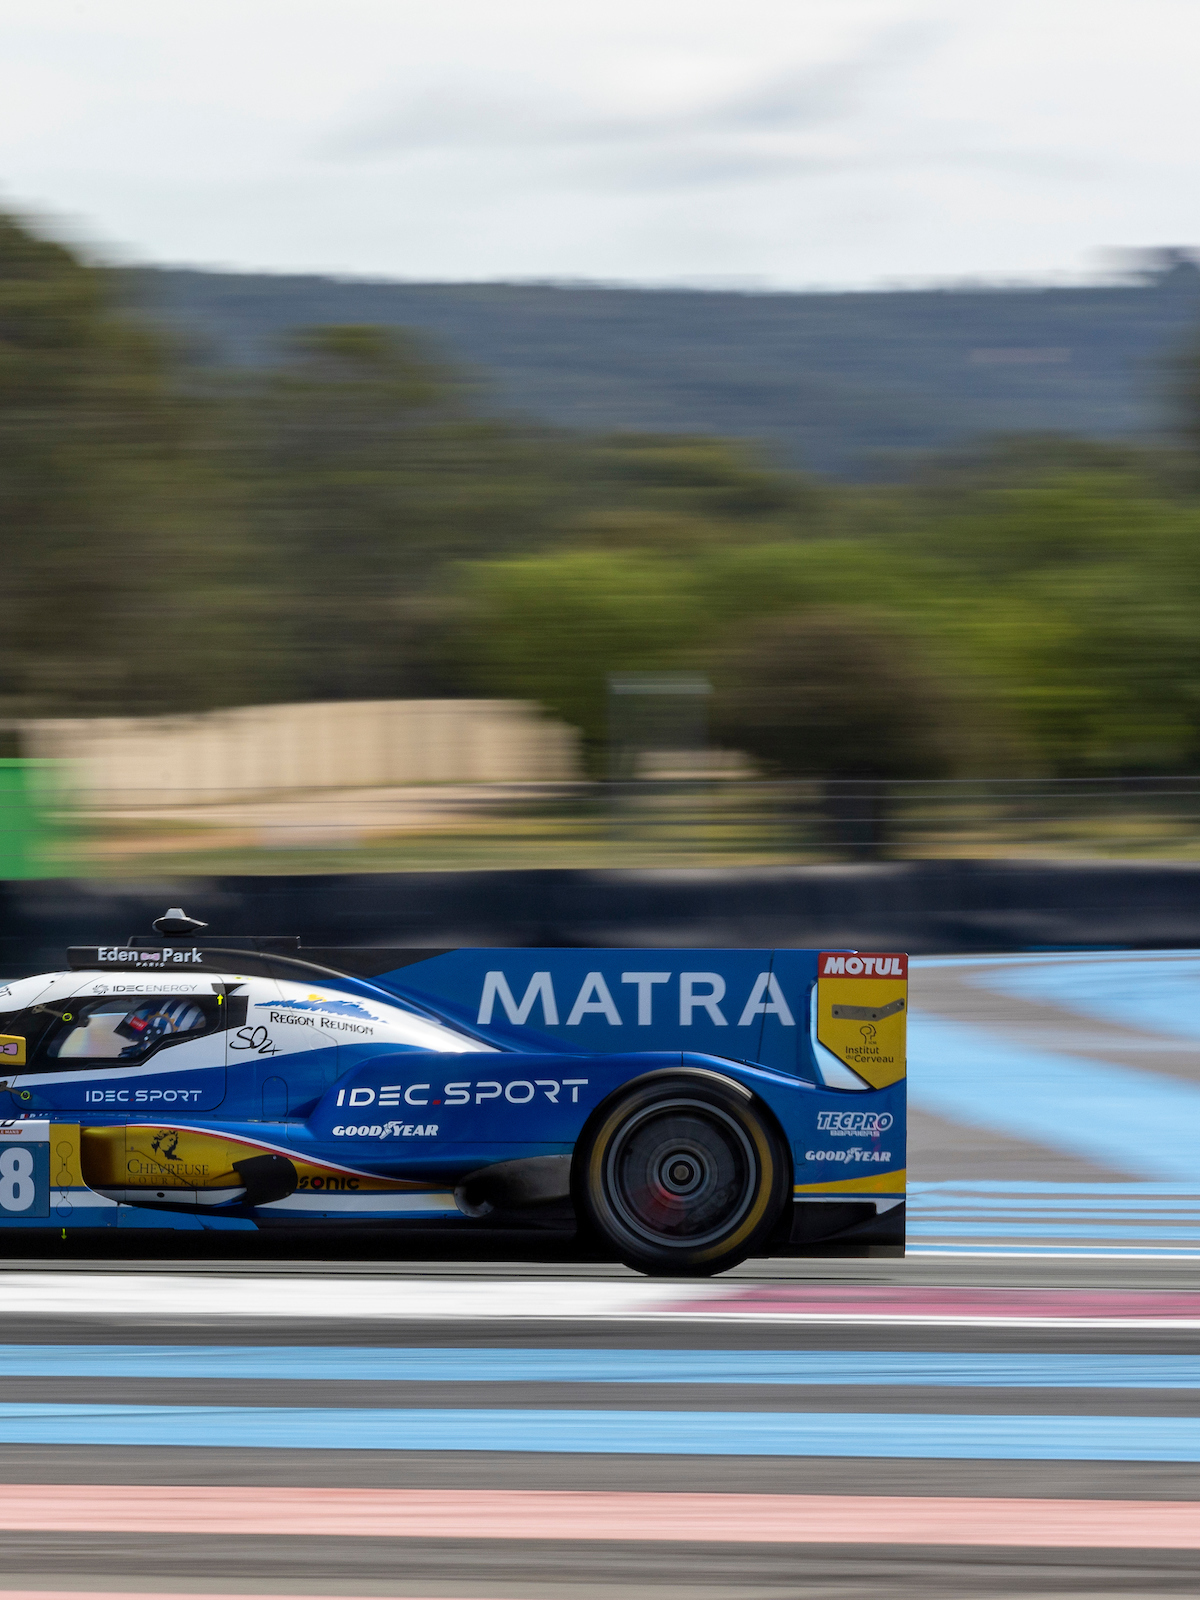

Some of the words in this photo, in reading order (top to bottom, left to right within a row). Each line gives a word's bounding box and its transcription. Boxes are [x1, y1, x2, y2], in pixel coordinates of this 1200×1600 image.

[97, 947, 139, 961] Eden
[162, 947, 203, 963] Park
[824, 956, 903, 976] MOTUL
[476, 970, 796, 1027] MATRA
[845, 1045, 880, 1055] Institut
[854, 1055, 895, 1064] Cerveau
[816, 1111, 894, 1132] TECPRO
